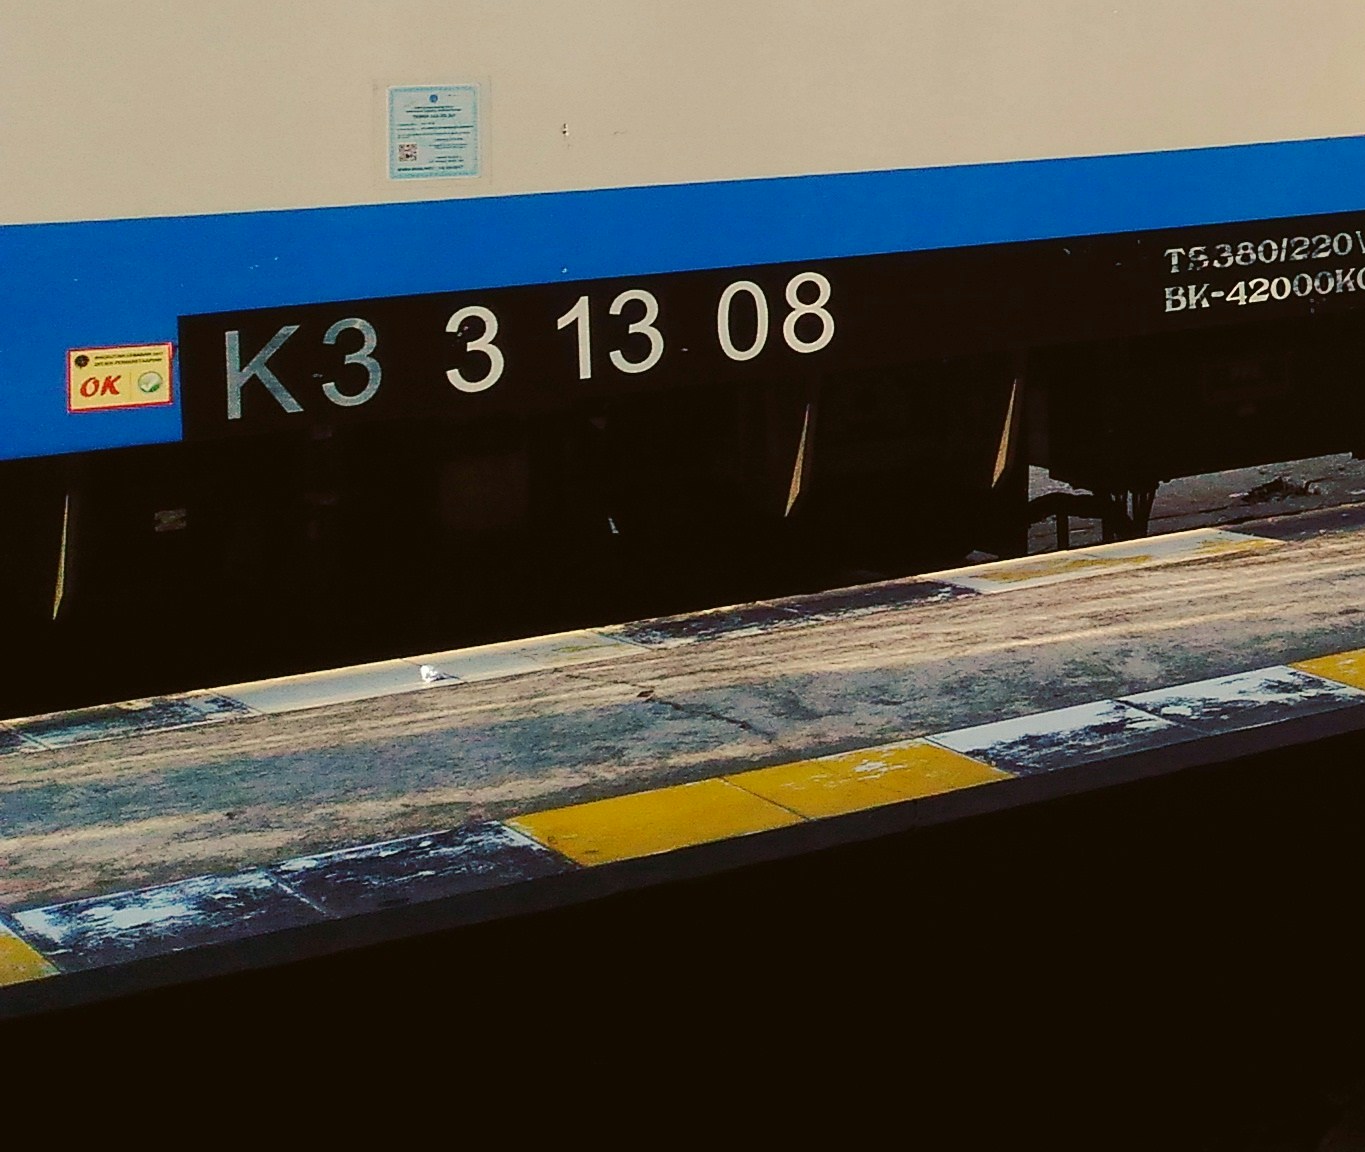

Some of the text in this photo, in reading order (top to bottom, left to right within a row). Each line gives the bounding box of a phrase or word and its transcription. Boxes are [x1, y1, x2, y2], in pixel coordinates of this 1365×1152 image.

[80, 375, 121, 398] OK
[225, 271, 837, 421] K3 3 13 08
